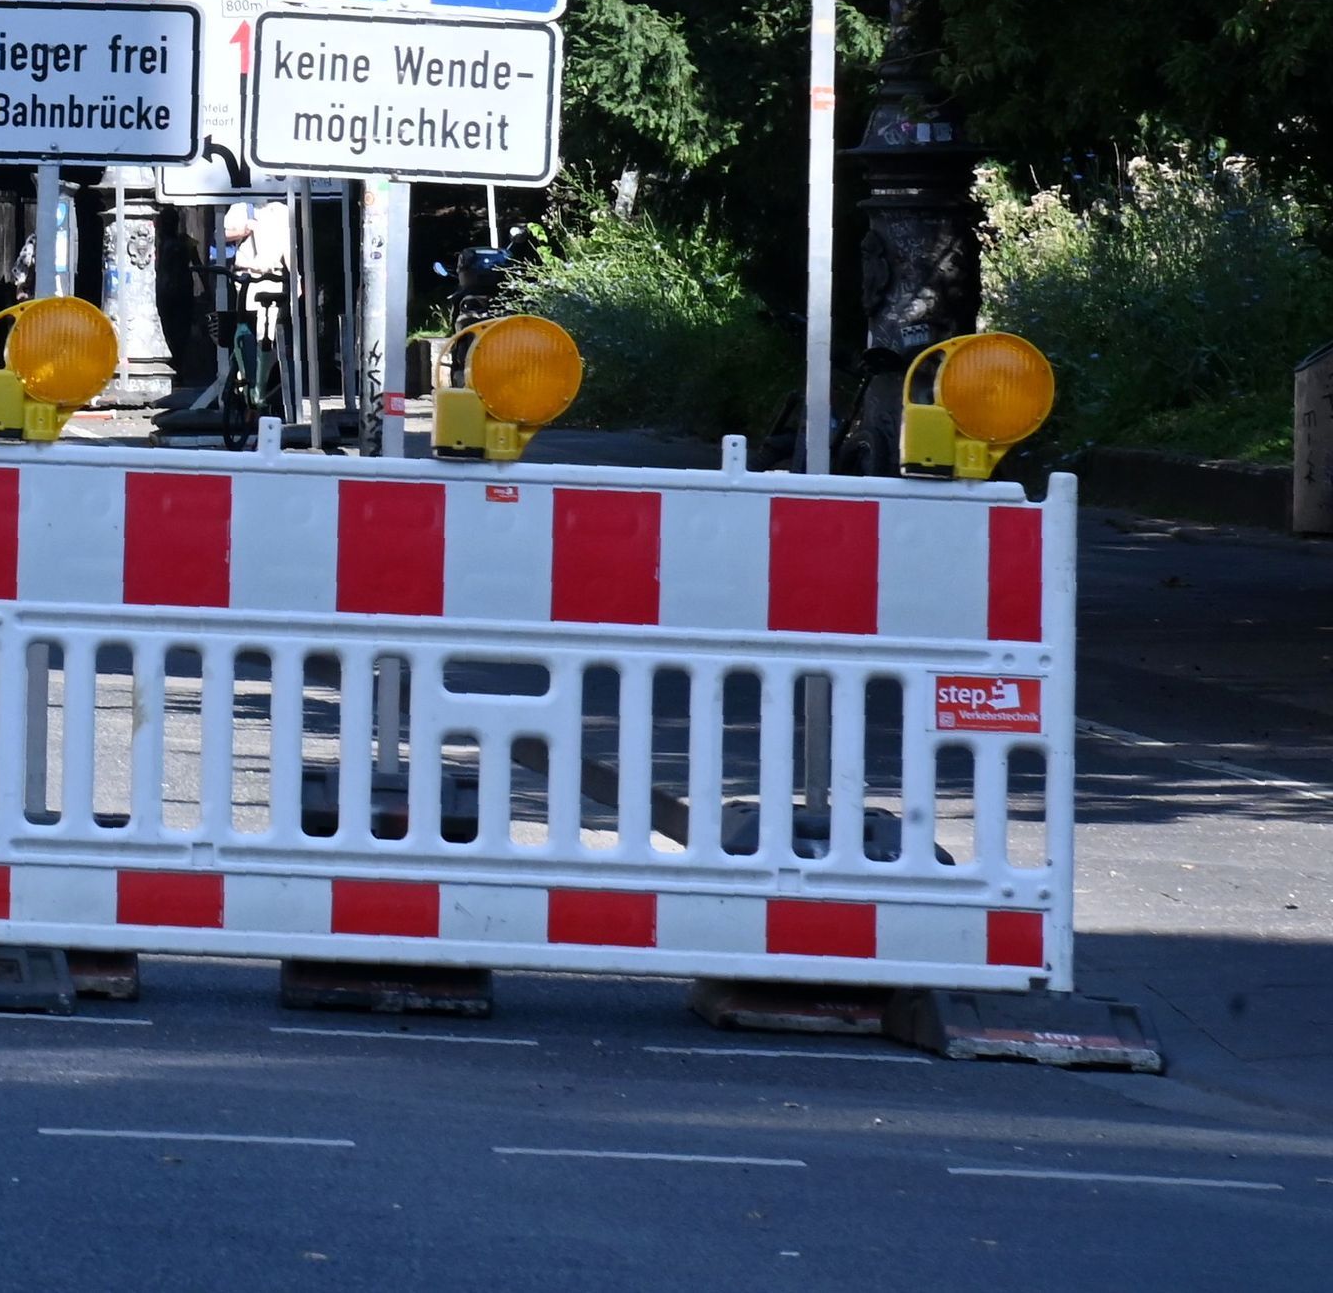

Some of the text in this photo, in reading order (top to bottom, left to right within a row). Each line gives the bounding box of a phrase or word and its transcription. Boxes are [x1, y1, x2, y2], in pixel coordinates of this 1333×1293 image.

[108, 34, 168, 74] frei
[274, 40, 534, 90] keine Wende-
[293, 102, 509, 155] möglichkeit
[938, 685, 987, 710] step
